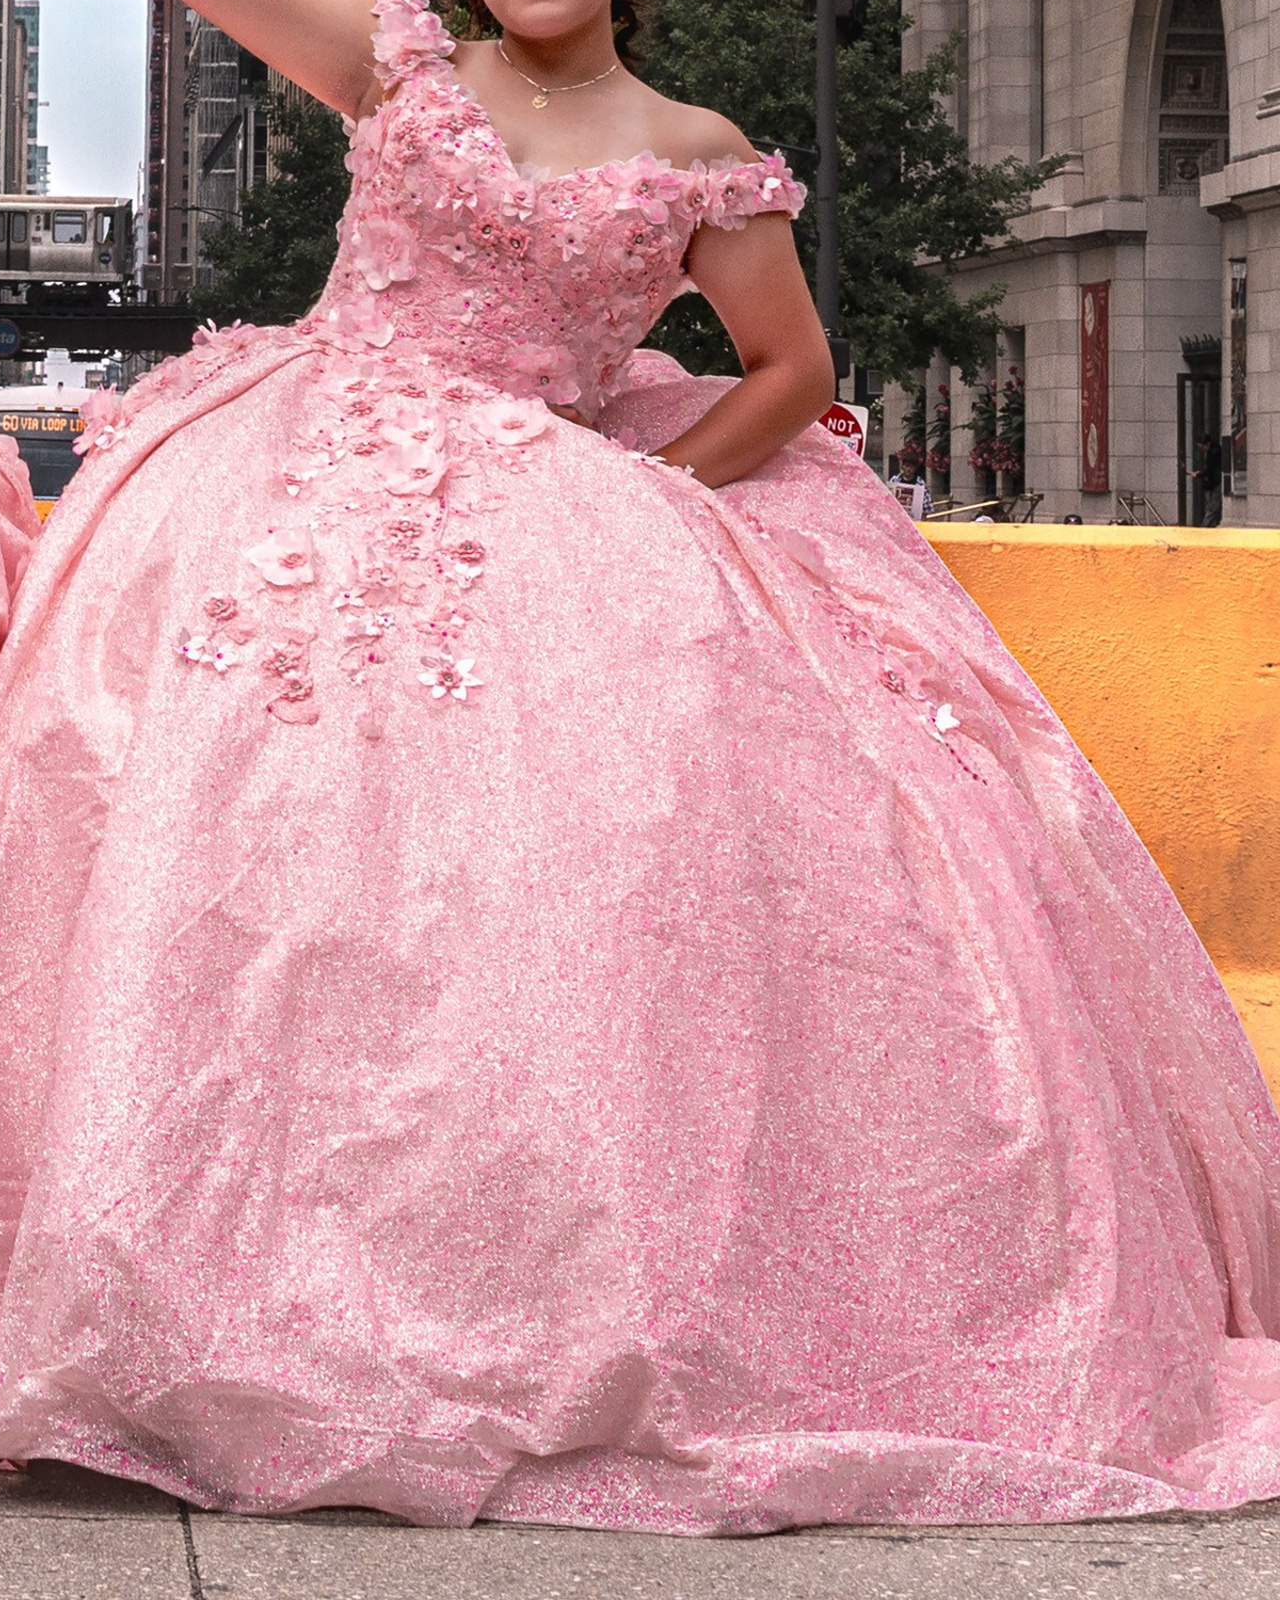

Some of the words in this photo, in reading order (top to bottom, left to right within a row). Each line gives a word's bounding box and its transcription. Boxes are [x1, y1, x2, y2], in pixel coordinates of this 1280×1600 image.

[2, 414, 18, 431] 60
[20, 417, 38, 431] VIA
[42, 417, 67, 431] LOOP
[69, 418, 87, 432] LIN
[826, 417, 855, 433] NOT
